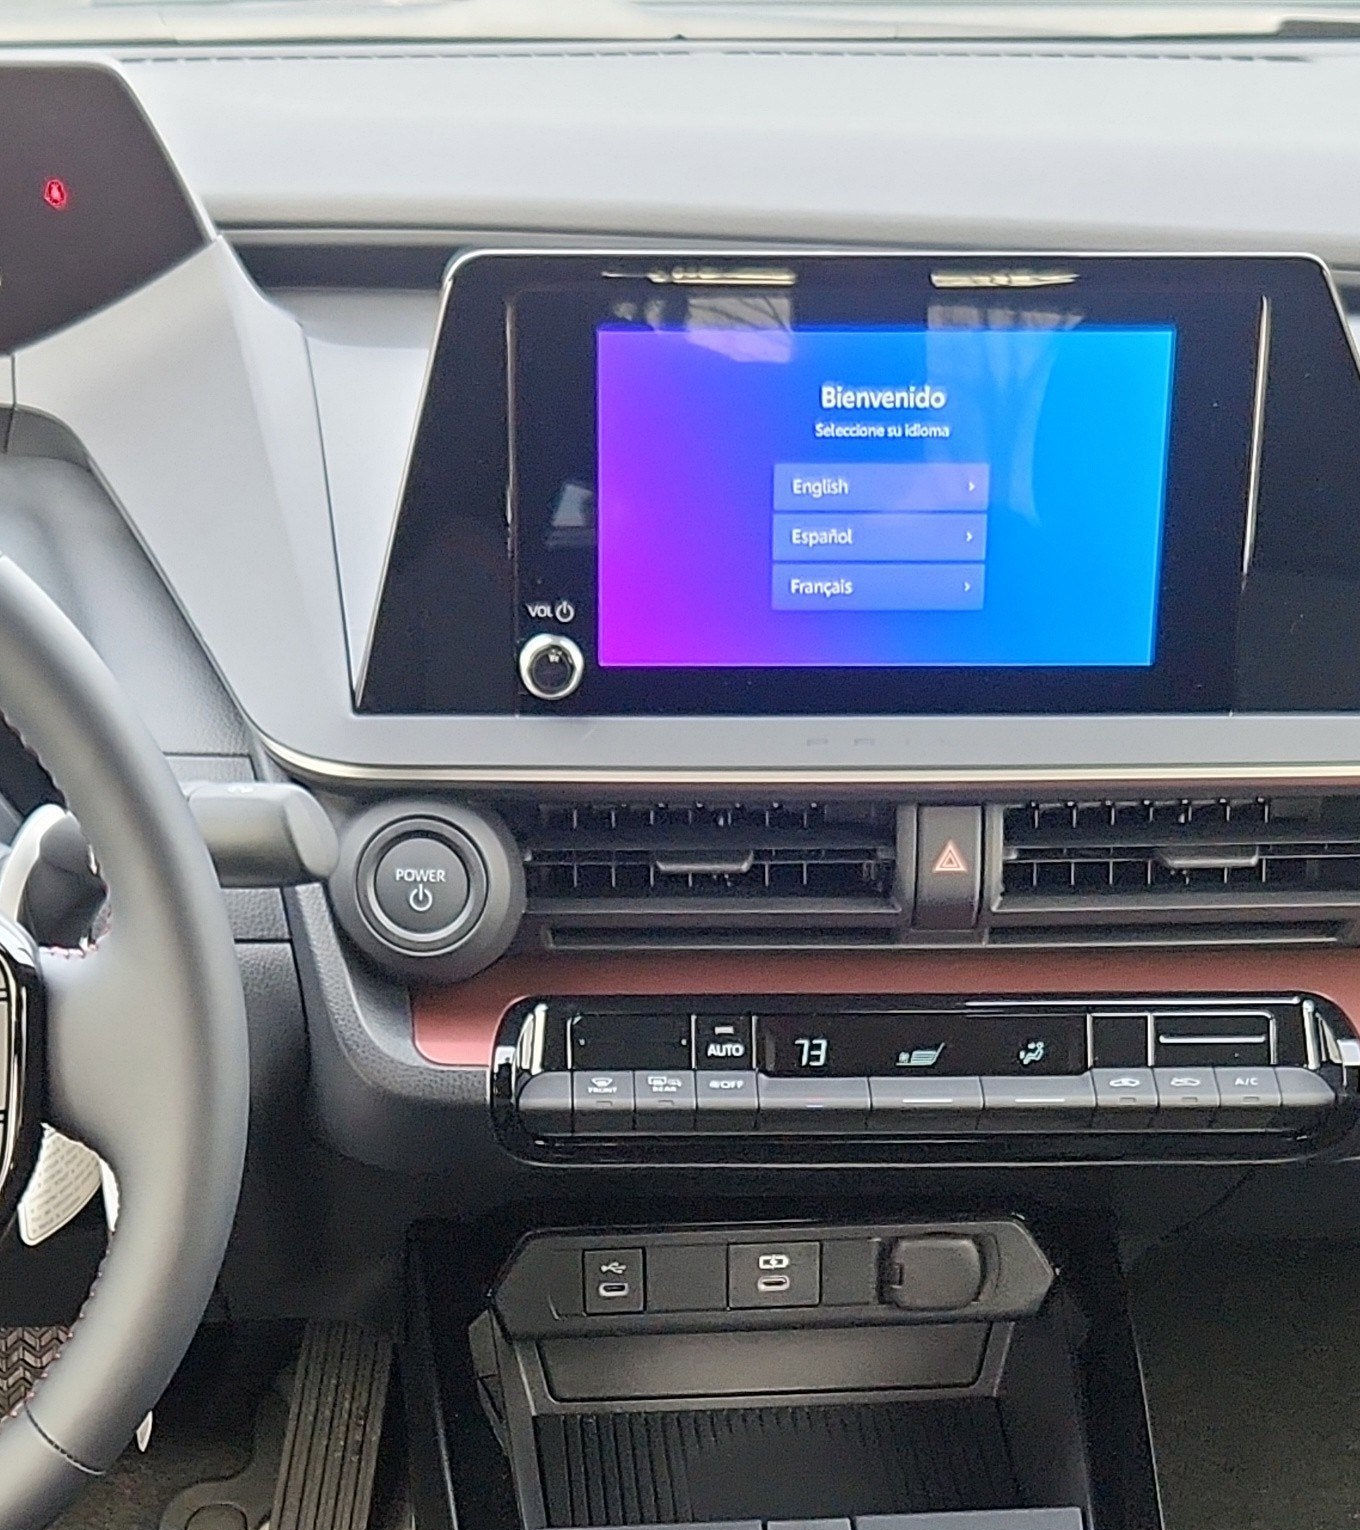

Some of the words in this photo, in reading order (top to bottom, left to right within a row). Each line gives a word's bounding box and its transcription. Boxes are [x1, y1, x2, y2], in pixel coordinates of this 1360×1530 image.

[820, 385, 947, 410] Bienvenido
[814, 423, 885, 438] Seleccione
[886, 425, 902, 438] su
[904, 423, 950, 438] idioma
[791, 478, 849, 498] English
[791, 528, 854, 547] Español
[789, 578, 854, 598] Français
[526, 604, 554, 618] VOL
[395, 867, 447, 885] POWER
[706, 1043, 745, 1057] AUTO
[794, 1038, 828, 1067] 73
[1234, 1076, 1259, 1087] A/C
